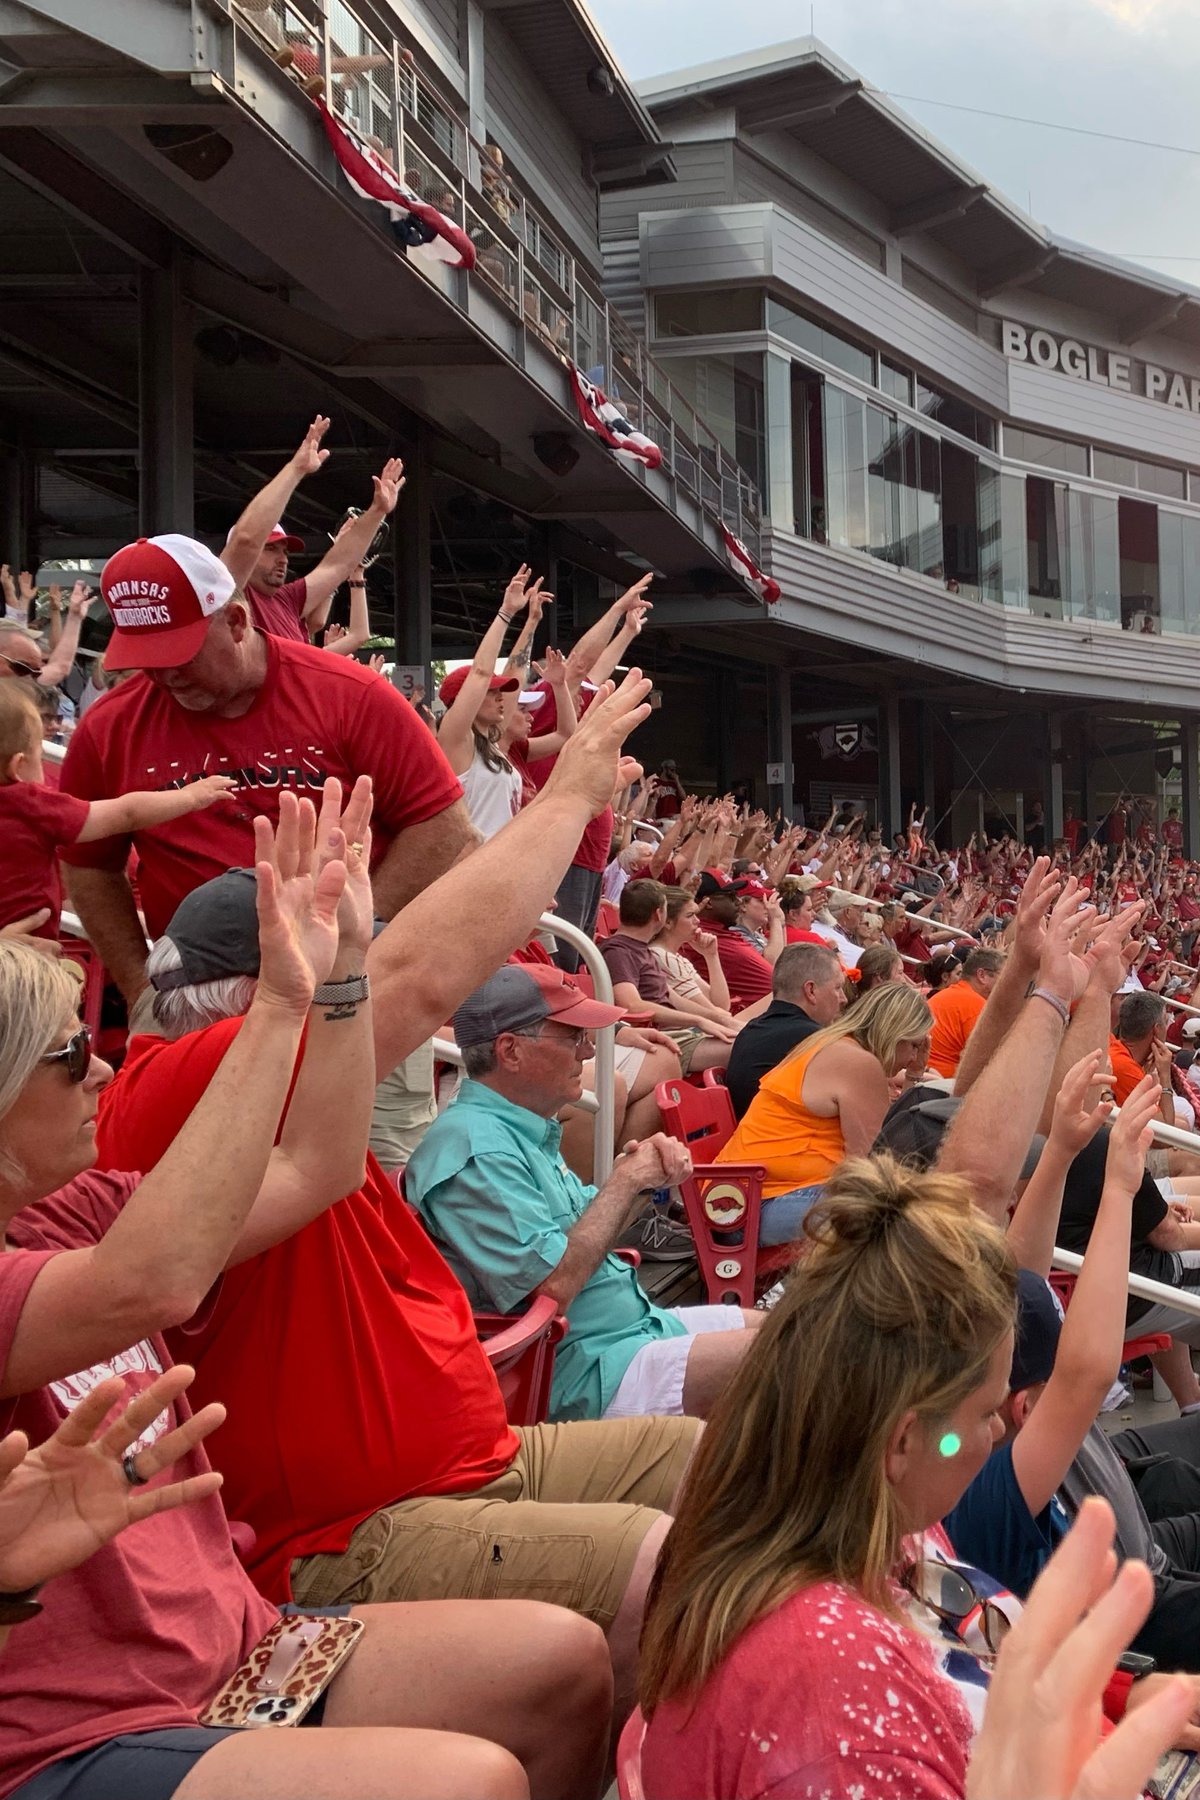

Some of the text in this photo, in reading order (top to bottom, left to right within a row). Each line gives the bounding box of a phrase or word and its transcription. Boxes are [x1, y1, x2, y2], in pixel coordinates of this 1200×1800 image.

[1002, 319, 1132, 392] BOGLE
[107, 580, 170, 604] ARKANSAS
[402, 674, 414, 690] 3
[771, 768, 780, 779] 4
[723, 1263, 733, 1274] G
